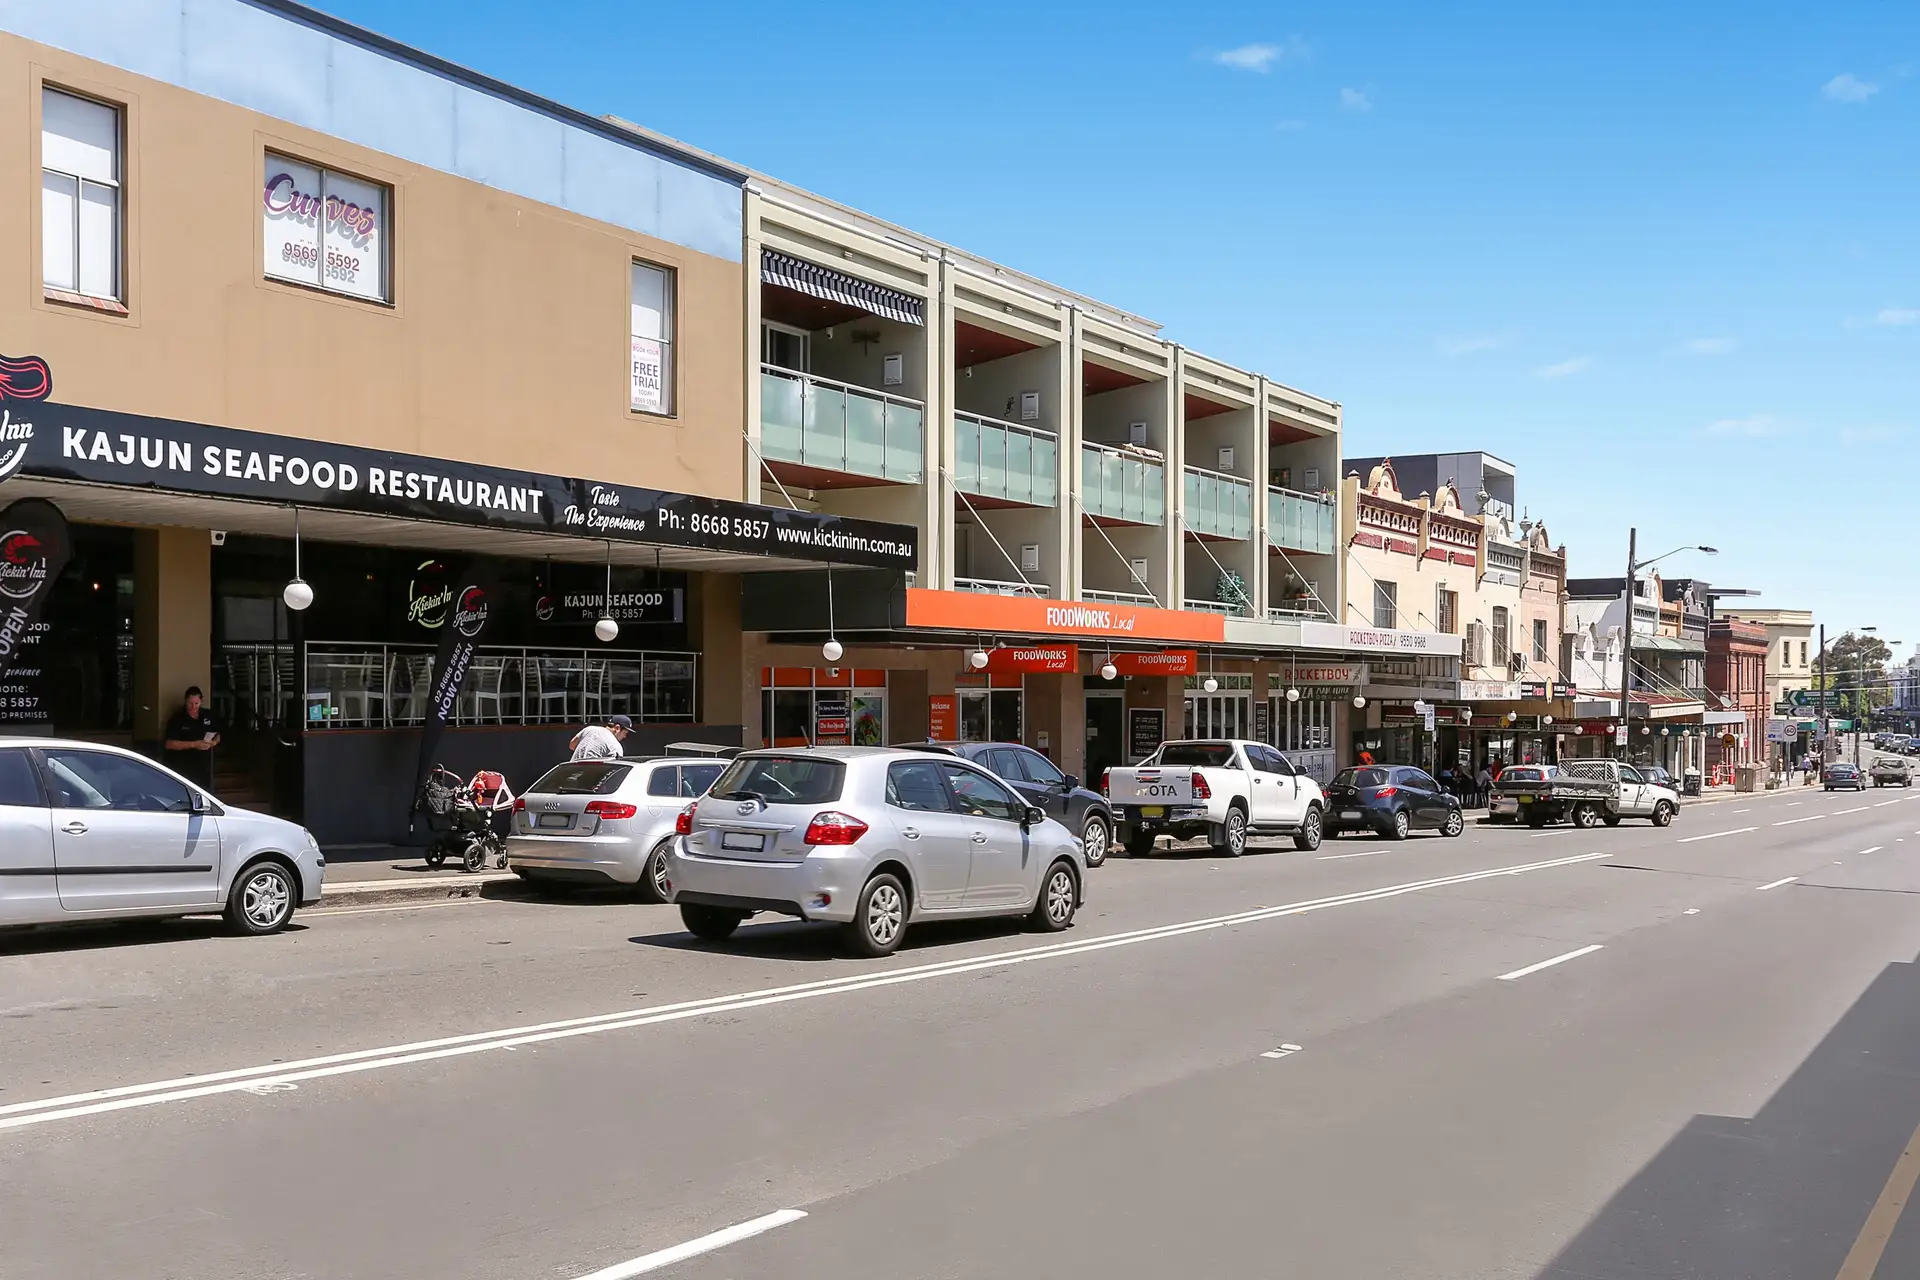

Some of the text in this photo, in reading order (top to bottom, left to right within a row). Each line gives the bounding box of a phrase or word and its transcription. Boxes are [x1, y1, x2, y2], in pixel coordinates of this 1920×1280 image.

[264, 173, 375, 235] Curves
[284, 242, 318, 262] 9569
[327, 252, 360, 272] 5592
[633, 361, 659, 378] FREE
[633, 374, 660, 391] TRIAL
[62, 426, 192, 472] KAJUN
[203, 445, 358, 492] SEAFOOD
[368, 466, 544, 514] RESTAURANT
[590, 486, 620, 507] Taste
[564, 505, 645, 533] The Experience
[658, 508, 913, 558] Ph: 8668 5857 www.kickininn.com.au
[564, 593, 663, 607] KAJUN SEAFOOD
[582, 610, 597, 619] Ph:
[622, 608, 644, 618] 5857
[0, 606, 28, 655] OPEN
[1111, 615, 1136, 632] Local
[1349, 631, 1379, 646] ROCKETBOY
[1399, 635, 1413, 648] 9550
[1046, 660, 1066, 669] Local
[1168, 664, 1186, 672] Local
[437, 682, 458, 721] NOW
[454, 643, 474, 683] OPEN
[1284, 668, 1350, 681] ROCKETBOY
[10, 697, 39, 708] 5857
[9, 711, 48, 719] PREMISES
